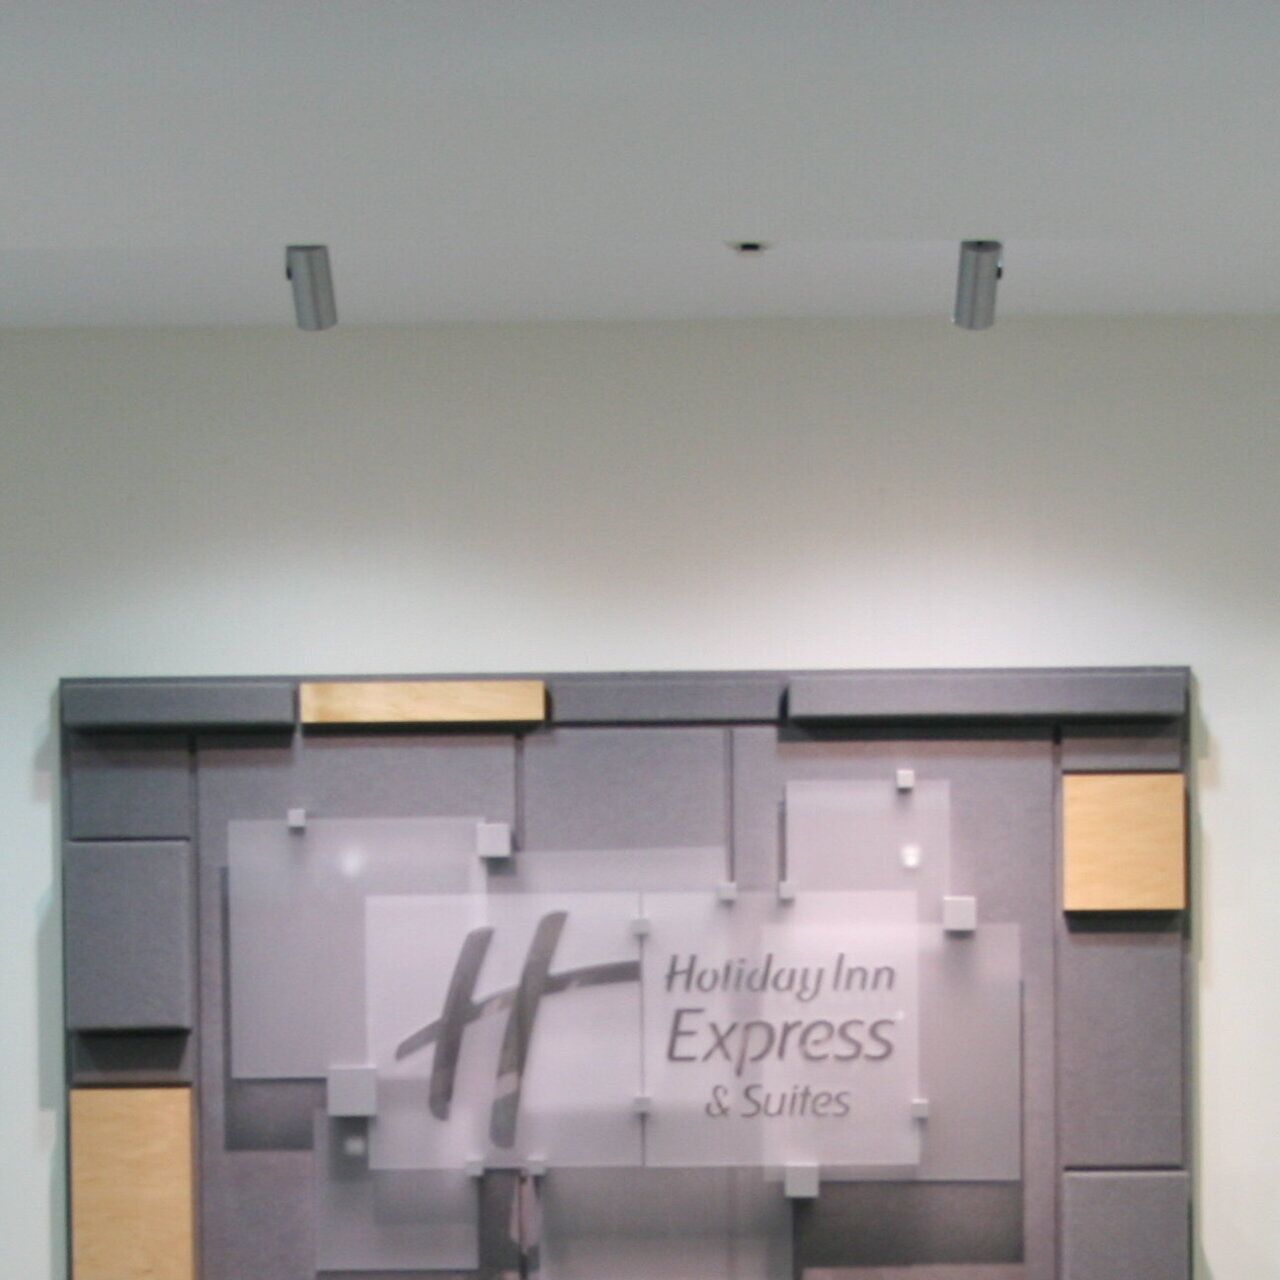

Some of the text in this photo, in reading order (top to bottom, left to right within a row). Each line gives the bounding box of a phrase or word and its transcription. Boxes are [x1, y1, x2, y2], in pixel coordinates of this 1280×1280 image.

[665, 952, 897, 1001] Holiday Inn
[665, 1007, 897, 1077] Express
[704, 1082, 852, 1119] & Suites
